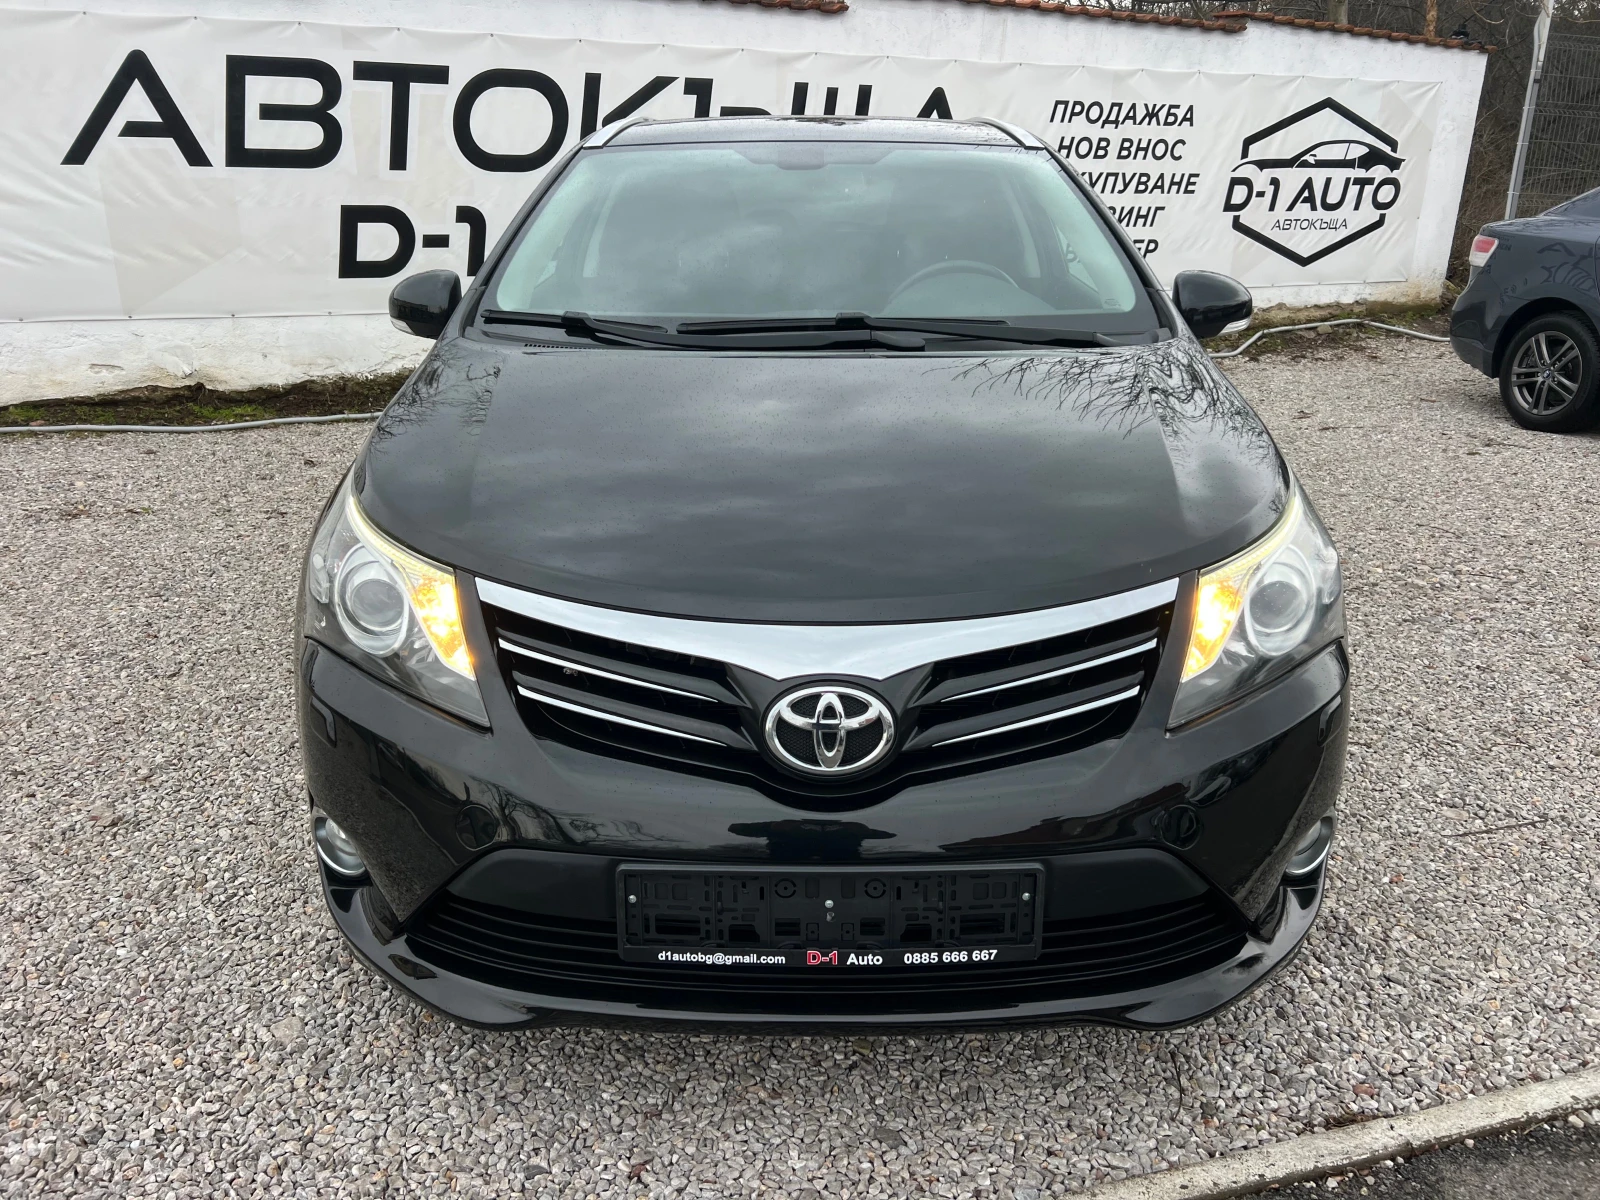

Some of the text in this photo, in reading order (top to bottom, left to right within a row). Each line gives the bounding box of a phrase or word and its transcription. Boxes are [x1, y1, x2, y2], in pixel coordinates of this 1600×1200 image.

[1049, 99, 1194, 129] ПРОДАЖБА
[1058, 136, 1187, 161] НОВ ВНОС
[1080, 172, 1200, 195] УПУВАНЕ
[1223, 176, 1402, 212] D-1 AUTO
[1271, 218, 1348, 231] АВТОКЪЩА
[338, 204, 487, 279] D-1
[658, 951, 786, 965] d1autobg@gmail.com
[806, 951, 883, 965] D-1 Auto
[903, 950, 998, 965] 0885 666 667
